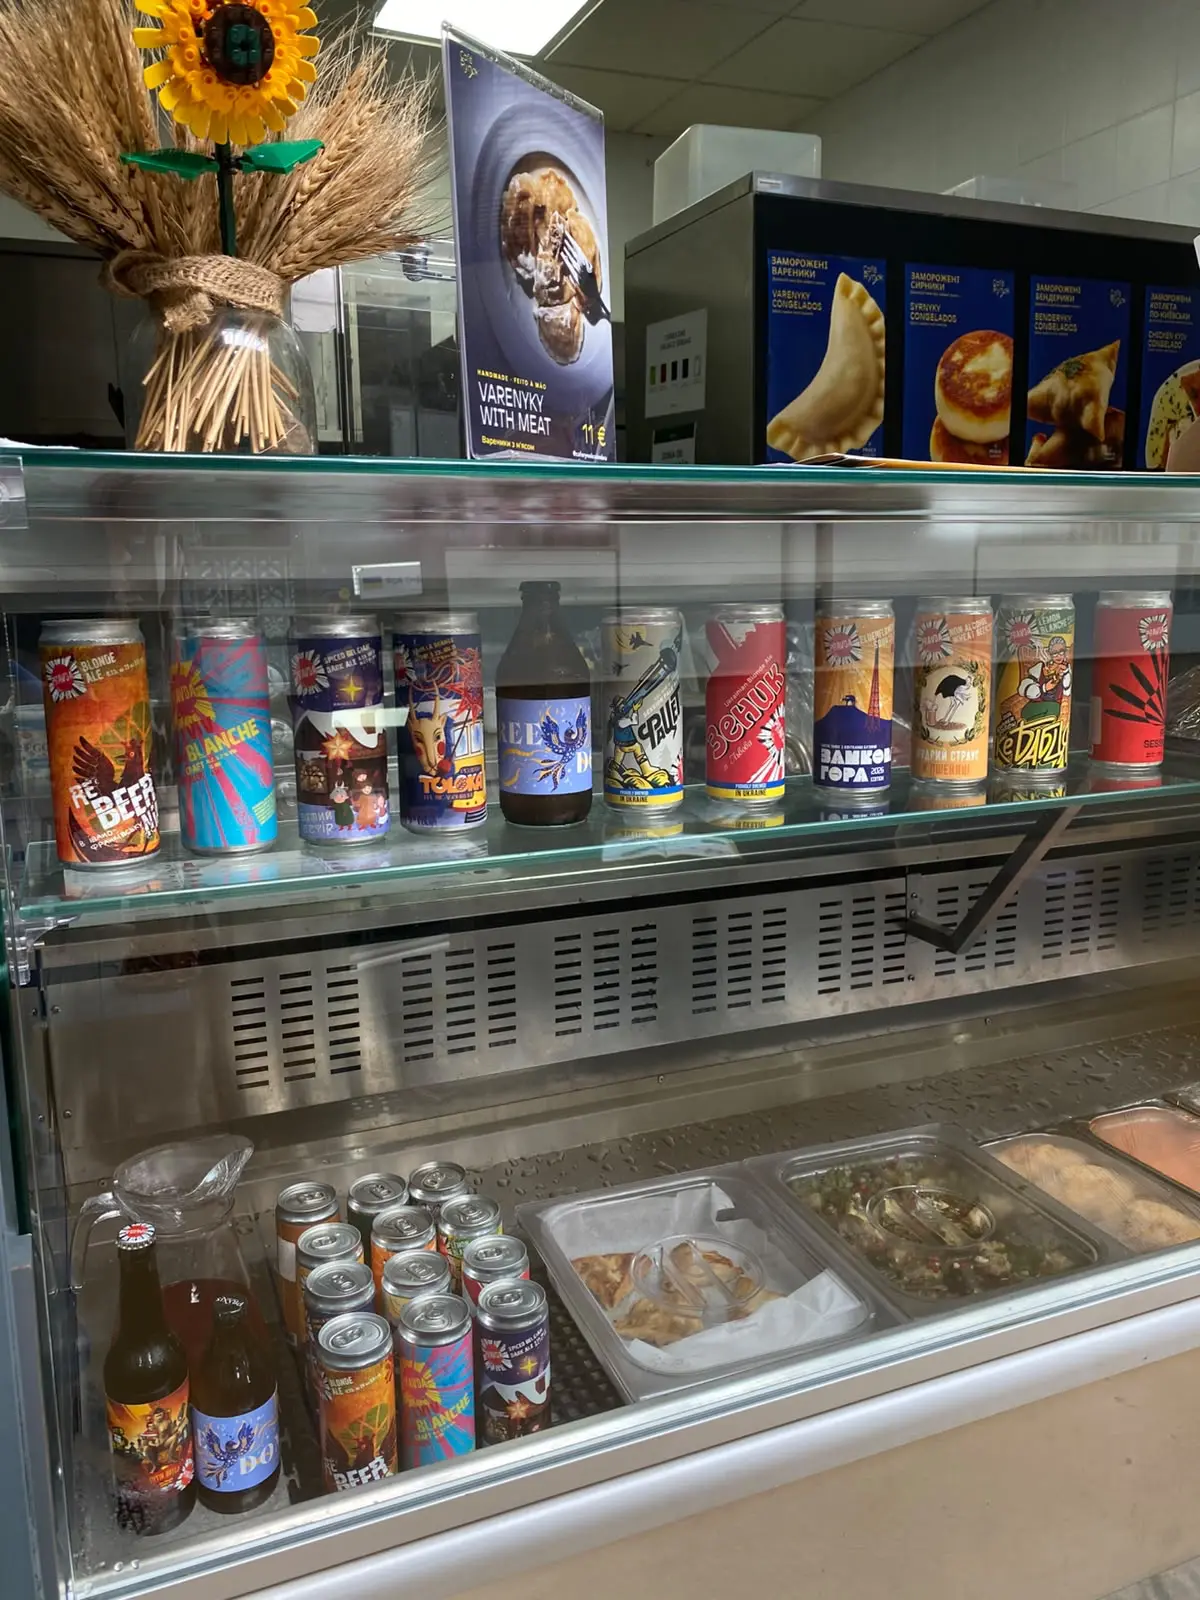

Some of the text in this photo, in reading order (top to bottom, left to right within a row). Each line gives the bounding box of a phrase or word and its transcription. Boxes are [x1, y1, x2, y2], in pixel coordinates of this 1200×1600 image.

[771, 256, 828, 270] ЗАМОРОЖЕНІ
[772, 266, 816, 279] ВАРЕНИКИ
[911, 271, 960, 284] ЗАМОРОЖЕНІ
[772, 289, 811, 300] VARENYKY
[772, 299, 822, 311] CONGELADOS
[910, 311, 957, 323] CONGELADOS
[477, 369, 509, 382] HANDMADE
[513, 376, 529, 387] FEITO
[478, 381, 544, 413] VARENYKY
[479, 404, 552, 436] WITH MEAT
[481, 435, 511, 449] Вареники
[582, 423, 606, 447] 11 €
[1039, 613, 1061, 624] LEMON
[80, 651, 117, 672] BLONDE
[85, 669, 105, 684] ALE
[723, 654, 773, 708] Ukrainian Blonde Ale
[186, 717, 260, 762] BLANCHE
[821, 765, 869, 783] ГОРА
[91, 773, 157, 831] BEER
[416, 1392, 470, 1433] BLANCHE
